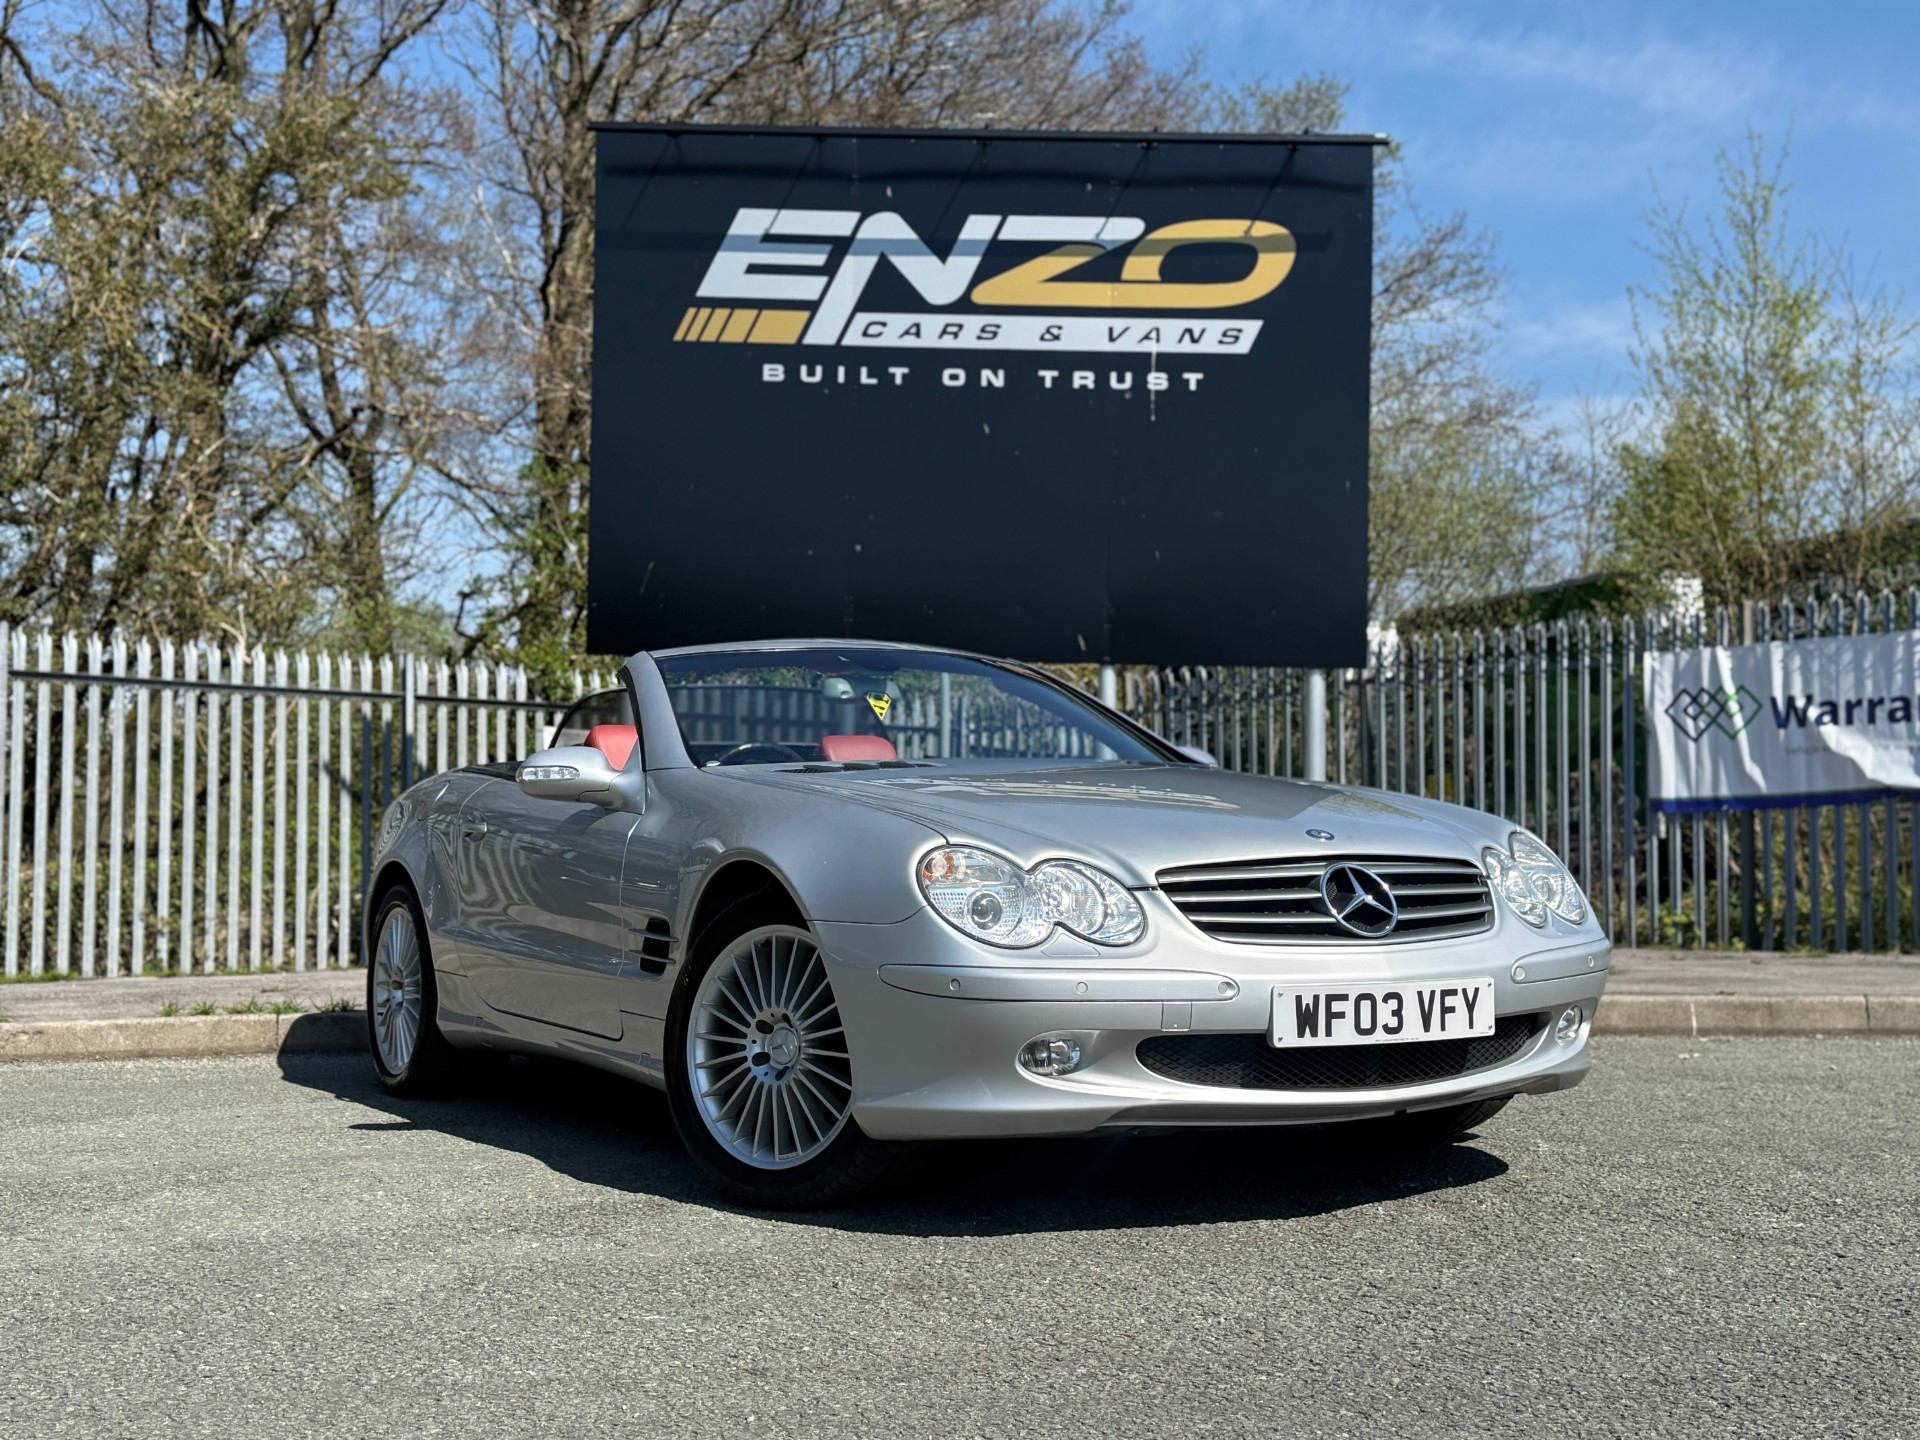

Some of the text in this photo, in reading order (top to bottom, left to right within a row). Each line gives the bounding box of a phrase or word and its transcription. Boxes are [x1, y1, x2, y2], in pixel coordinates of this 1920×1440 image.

[696, 208, 1296, 345] ENZO
[860, 320, 1244, 345] CARS & VANS
[762, 363, 1204, 391] BUILT ON TRUST
[1770, 692, 1920, 729] Warra
[1294, 987, 1481, 1039] WF03 VFY
